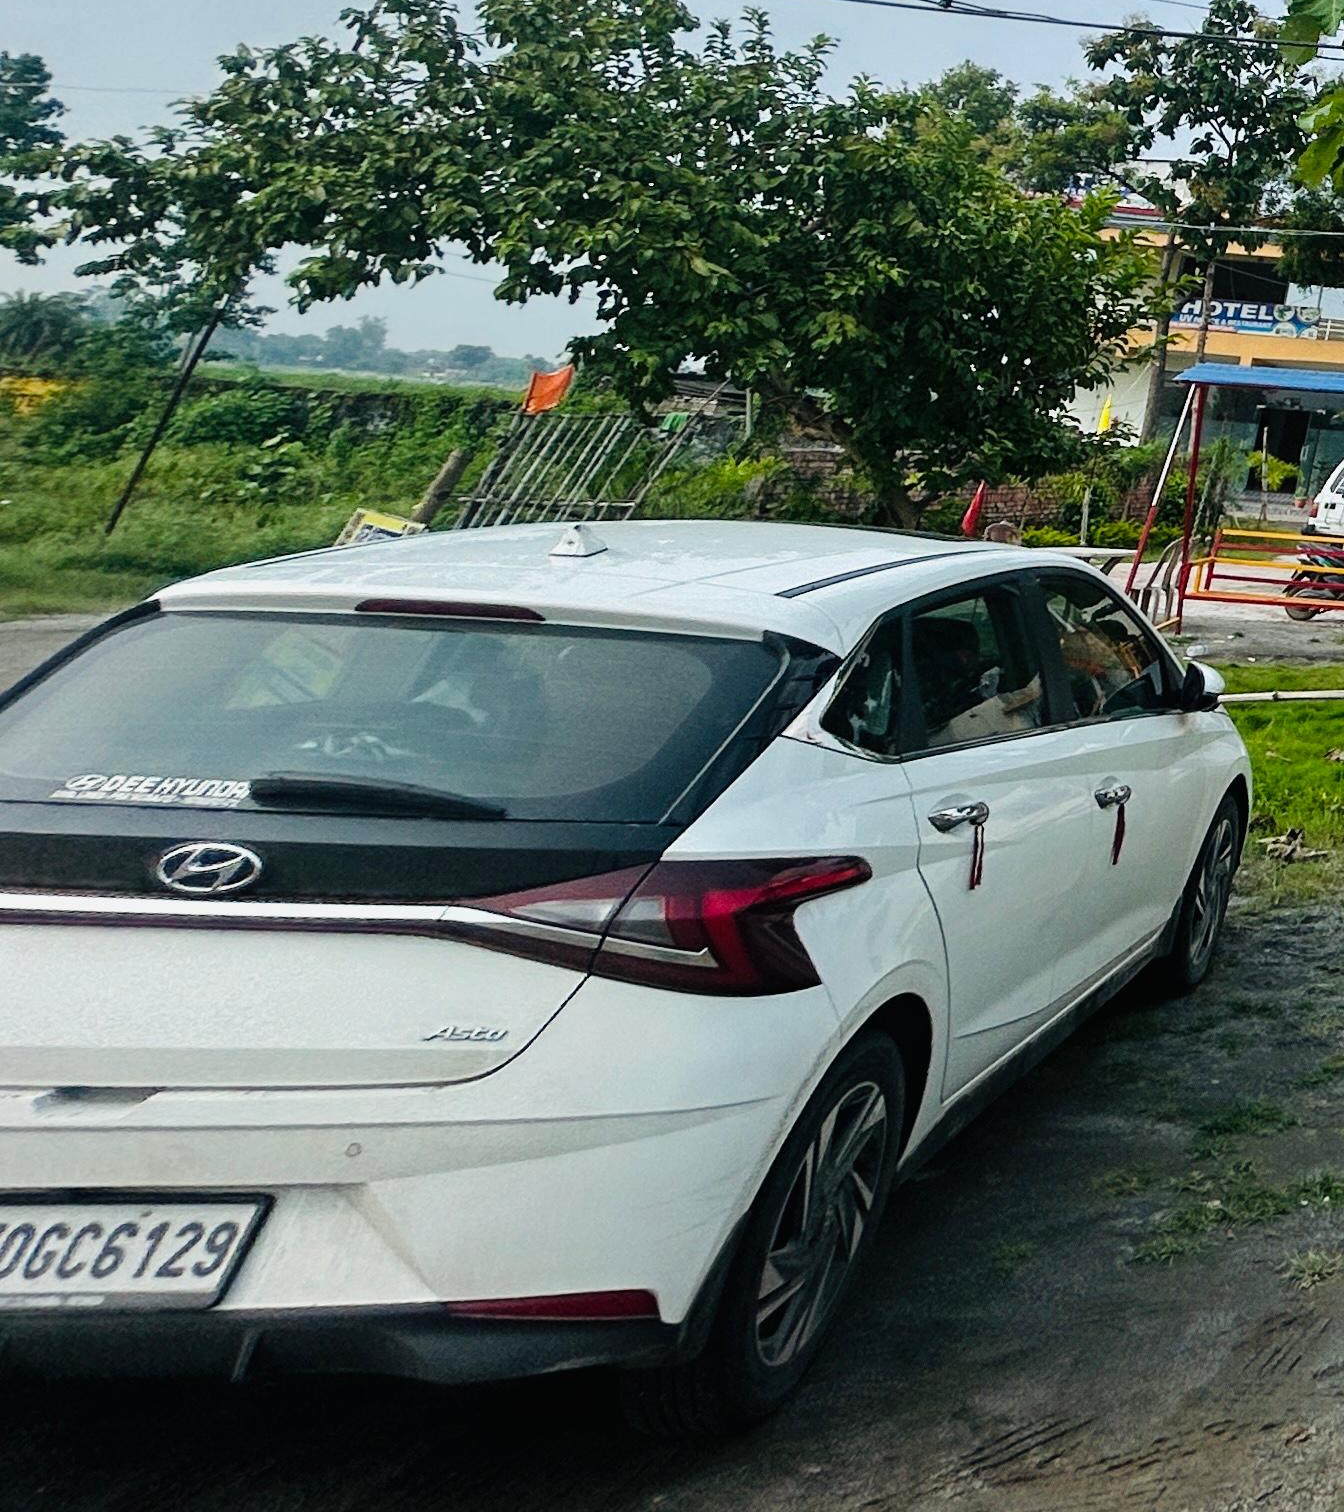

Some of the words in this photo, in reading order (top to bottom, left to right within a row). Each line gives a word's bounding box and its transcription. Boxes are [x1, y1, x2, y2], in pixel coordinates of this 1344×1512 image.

[1181, 300, 1274, 321] HOTEL
[421, 1025, 509, 1042] Asta
[0, 1221, 240, 1279] 0GC6129
